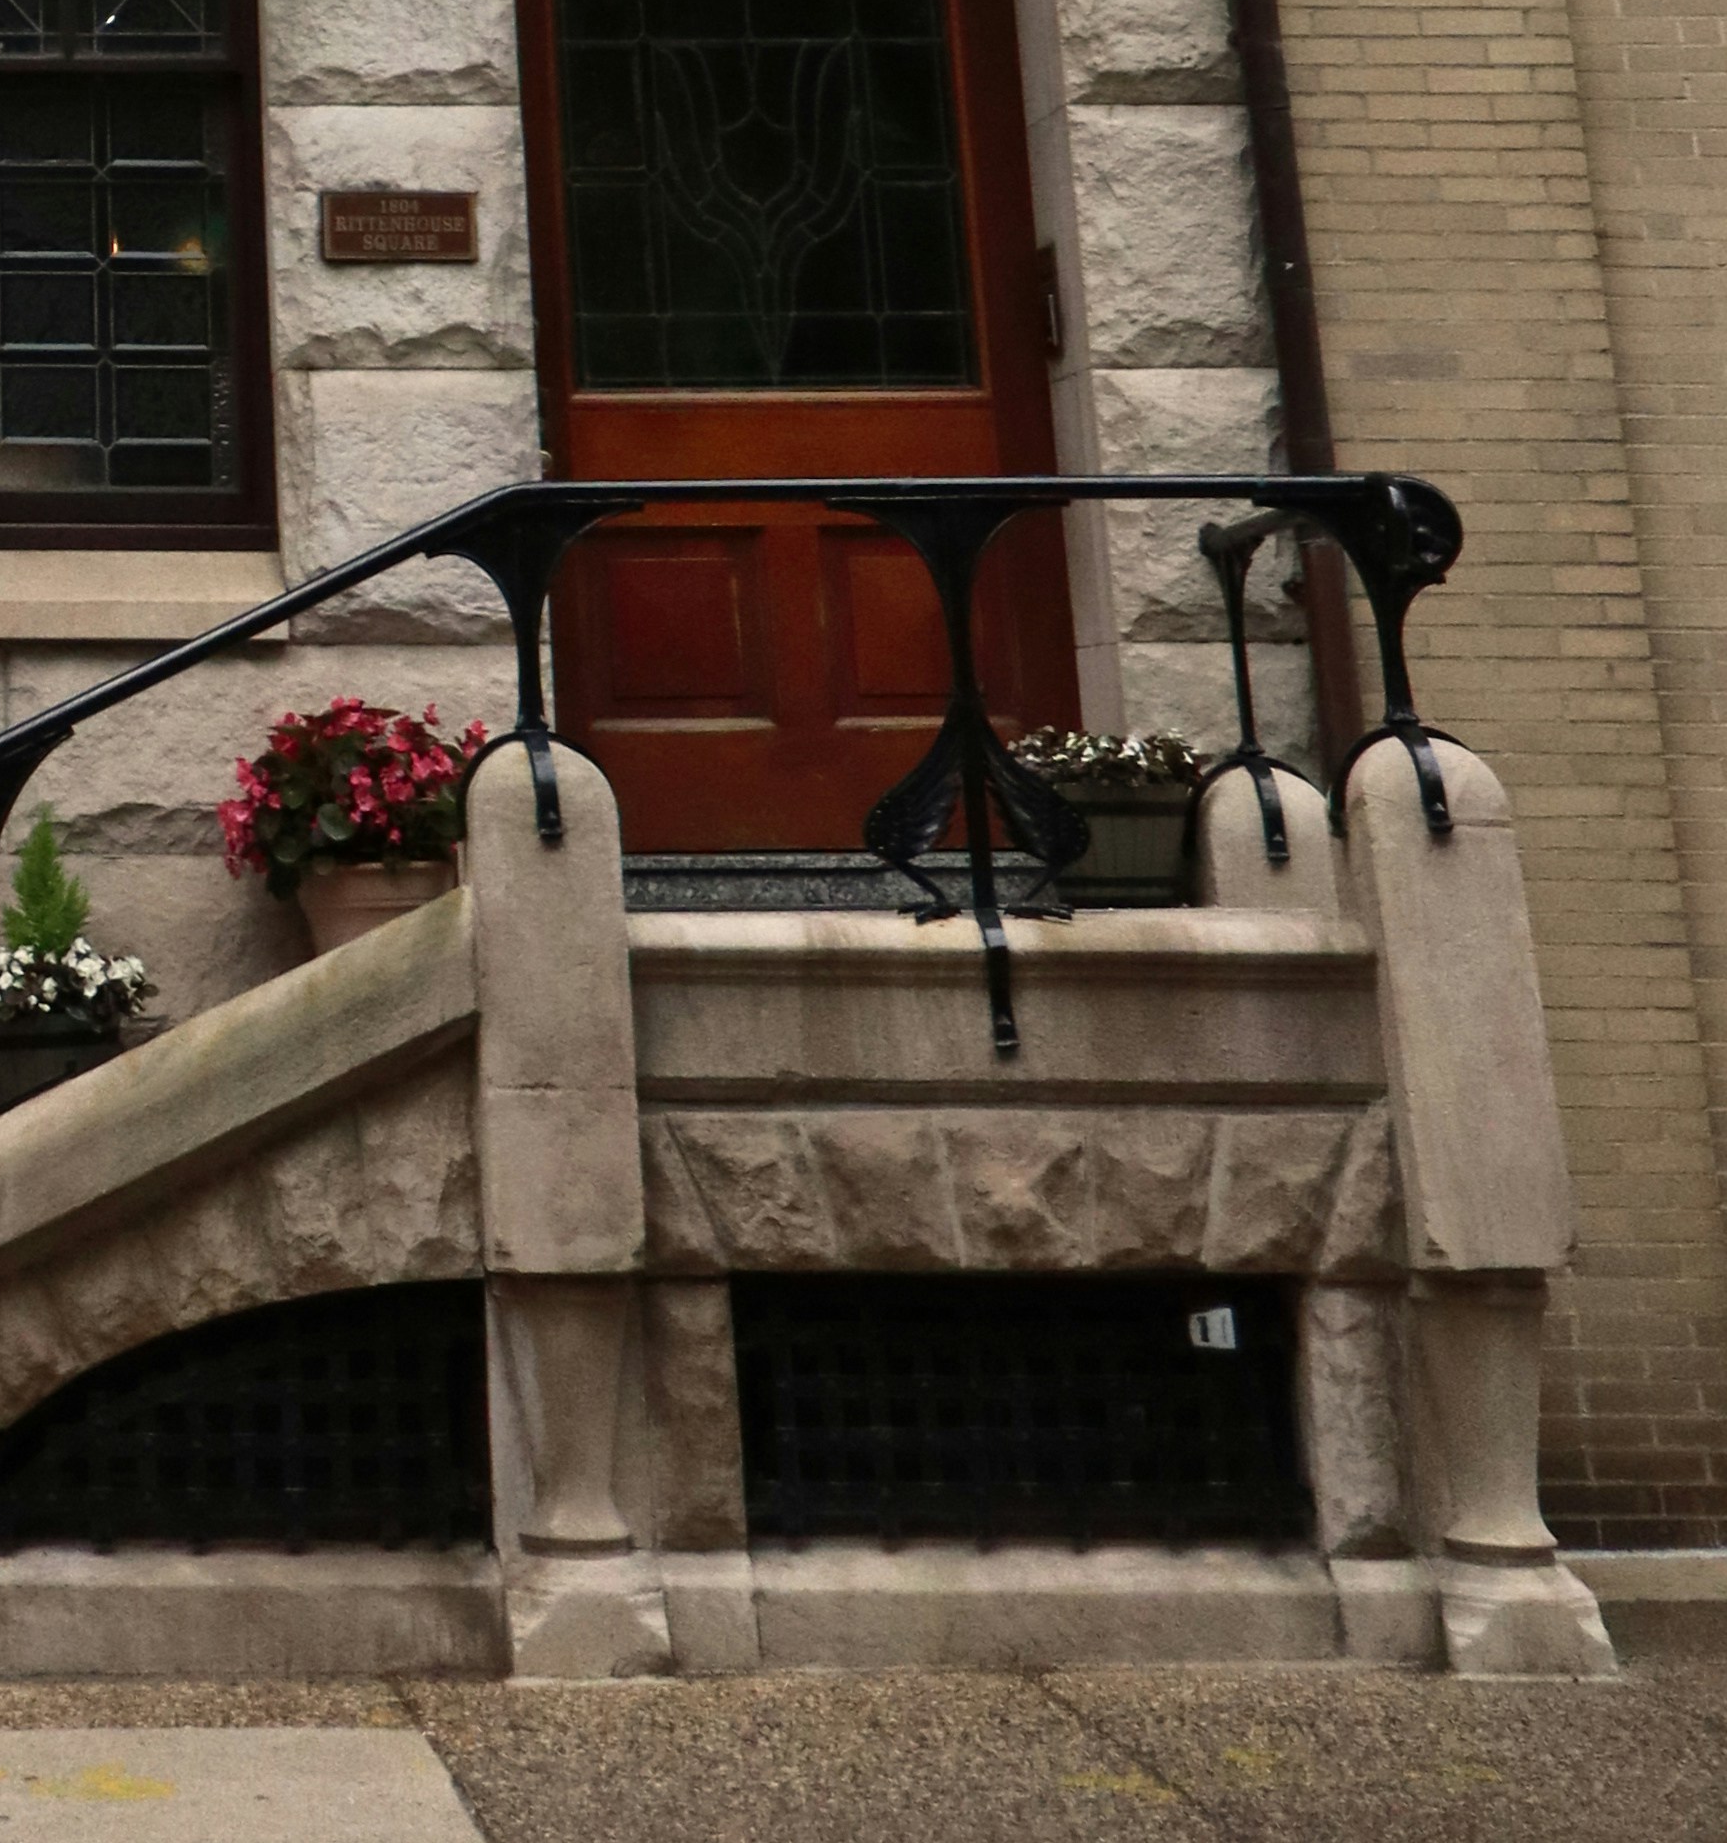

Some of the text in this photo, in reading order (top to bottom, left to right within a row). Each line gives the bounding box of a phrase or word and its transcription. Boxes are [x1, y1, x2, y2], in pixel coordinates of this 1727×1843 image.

[380, 199, 420, 214] 1804
[335, 216, 465, 232] RITTENHOUSE
[363, 234, 439, 252] SQUARE
